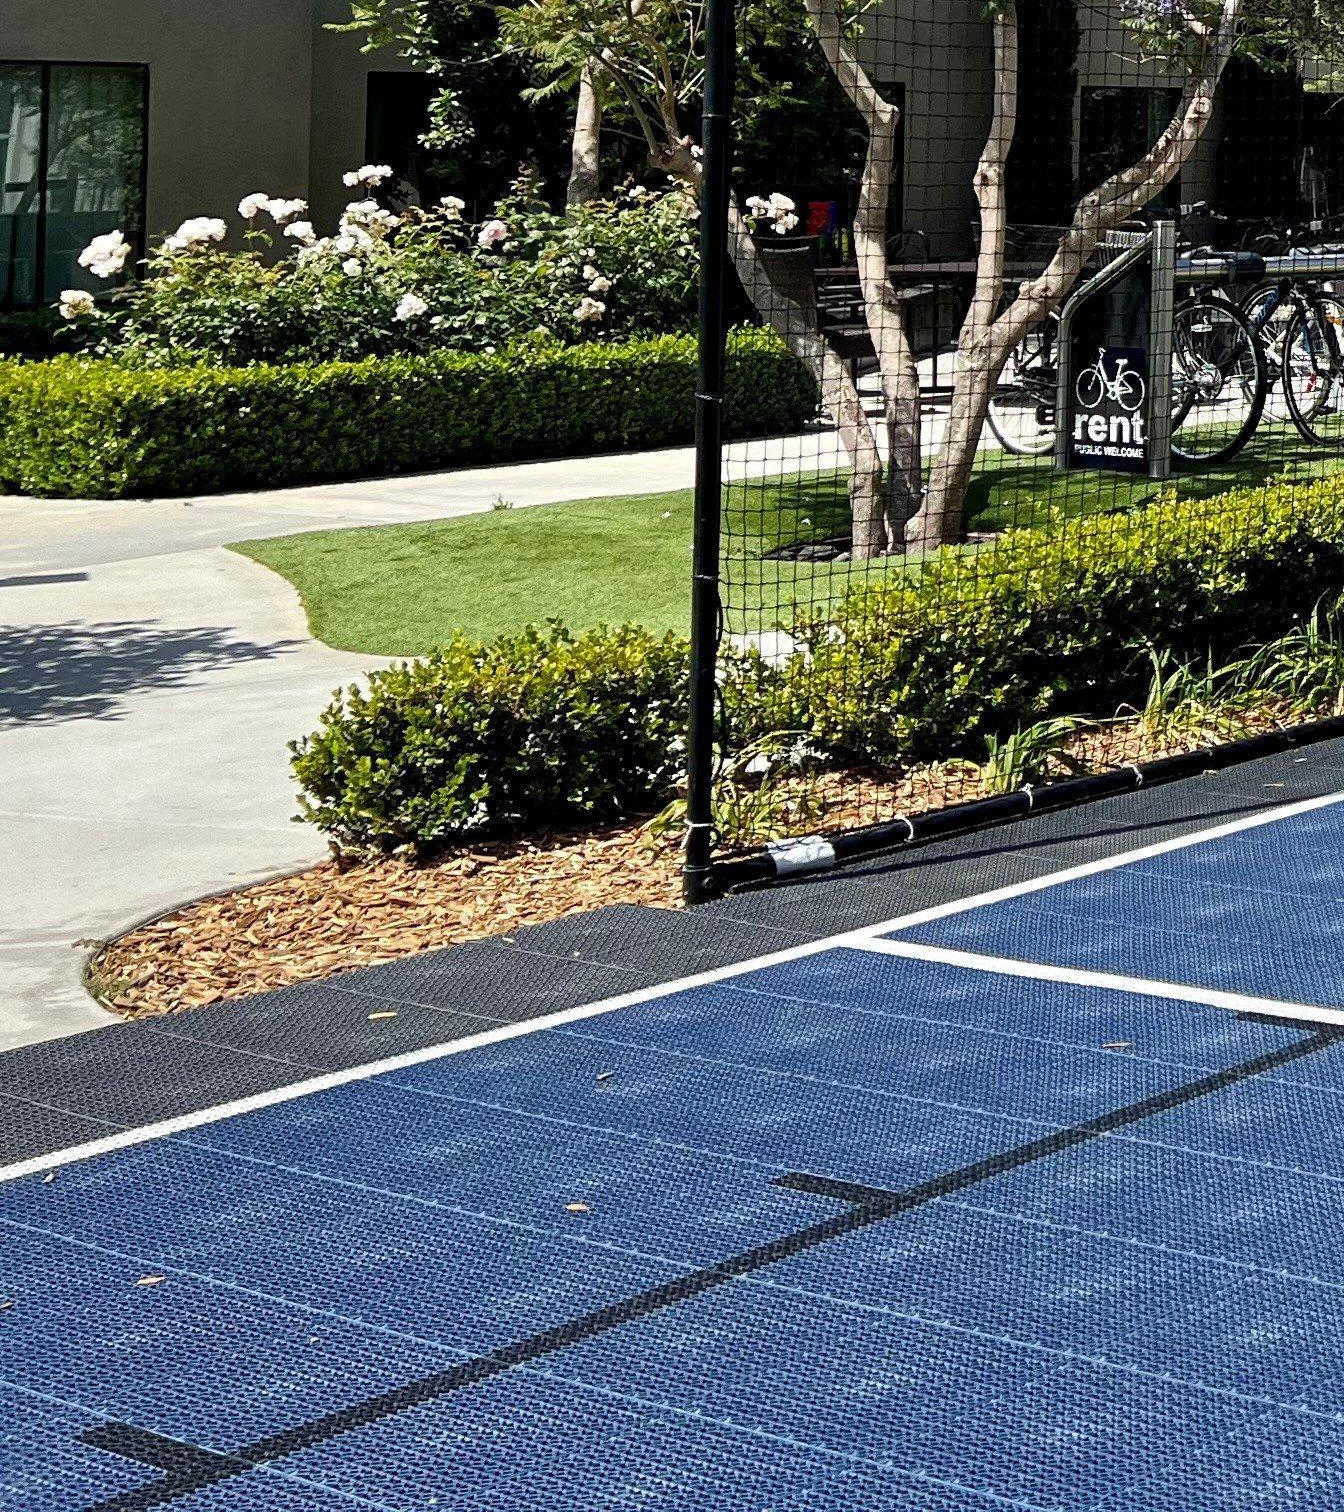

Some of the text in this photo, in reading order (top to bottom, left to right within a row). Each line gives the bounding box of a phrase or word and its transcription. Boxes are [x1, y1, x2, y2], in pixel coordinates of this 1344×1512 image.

[1073, 410, 1145, 445] rent
[1075, 444, 1144, 458] PUBLIC WELCOME
